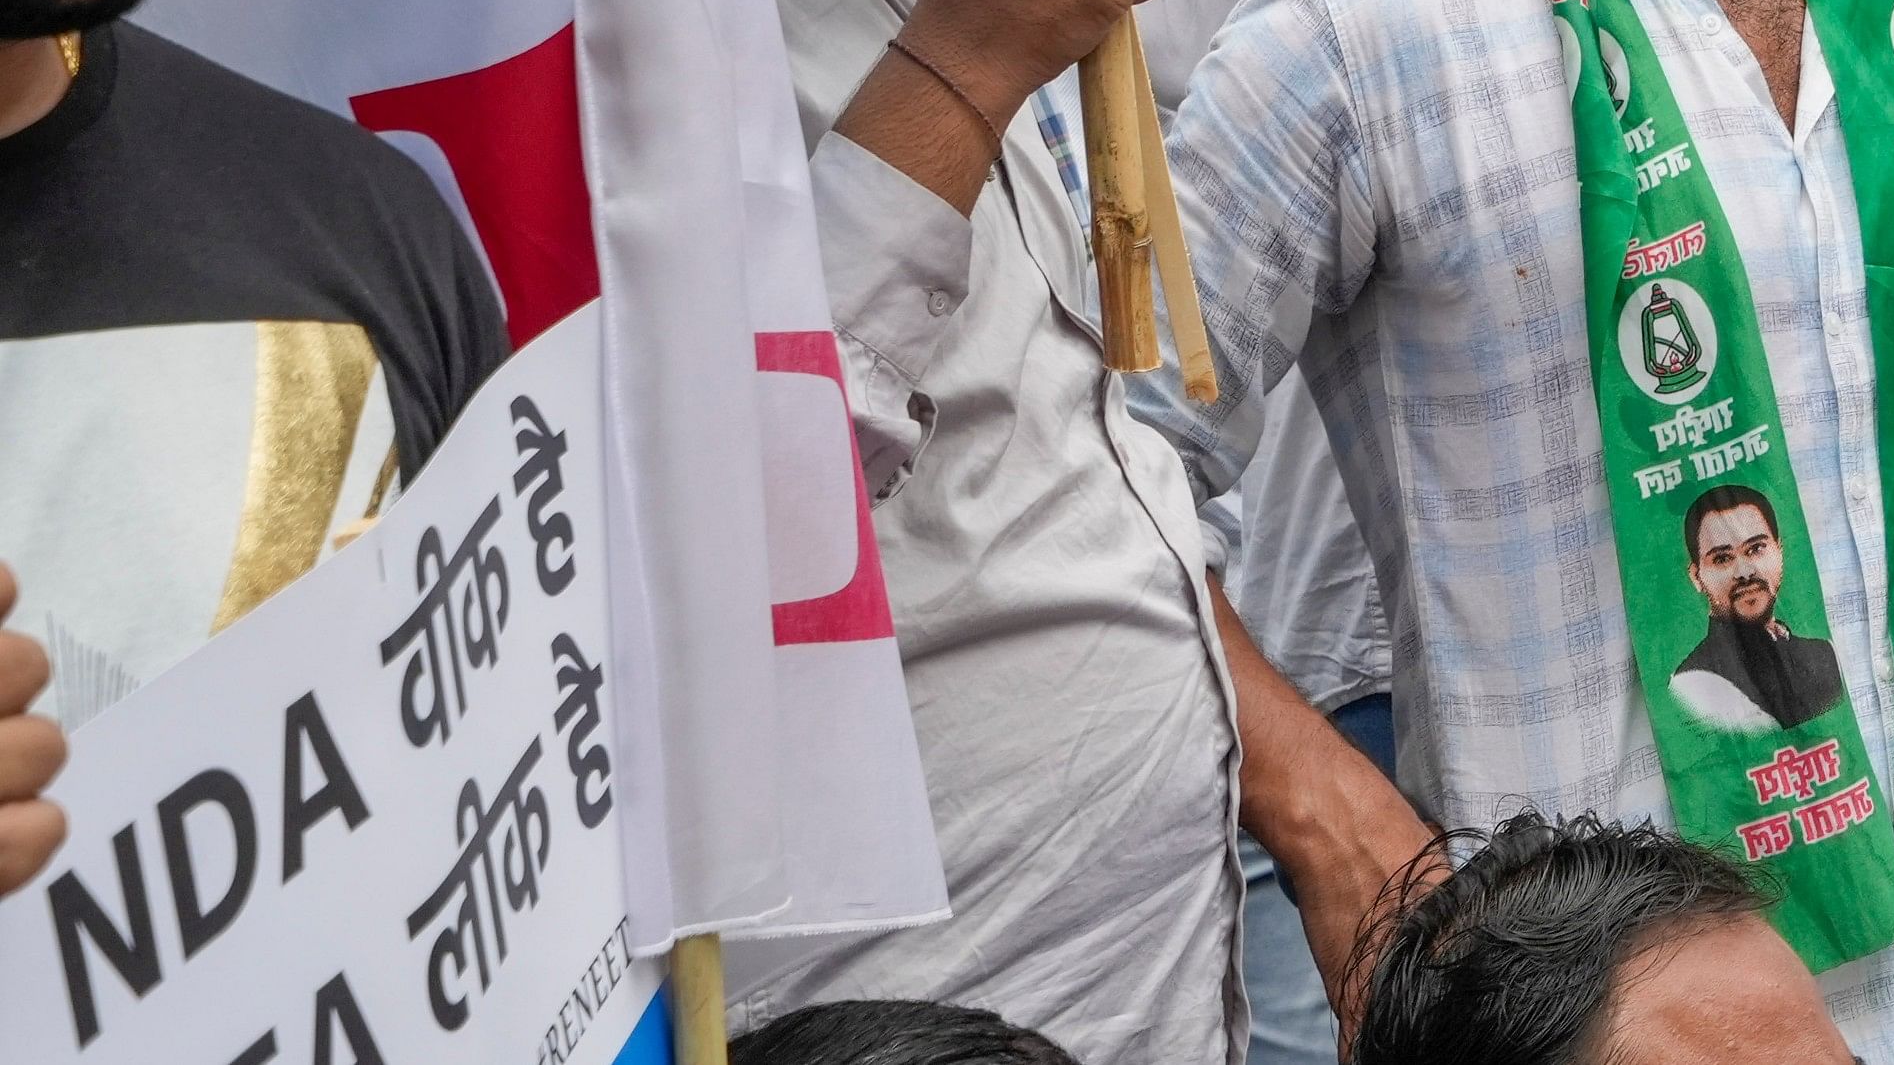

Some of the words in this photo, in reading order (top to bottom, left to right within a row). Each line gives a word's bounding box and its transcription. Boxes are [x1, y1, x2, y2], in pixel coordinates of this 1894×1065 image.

[47, 690, 371, 1051] NDA
[380, 495, 513, 750] वीक
[509, 395, 577, 597] है
[407, 735, 552, 1033] लीक
[552, 631, 615, 830] है
